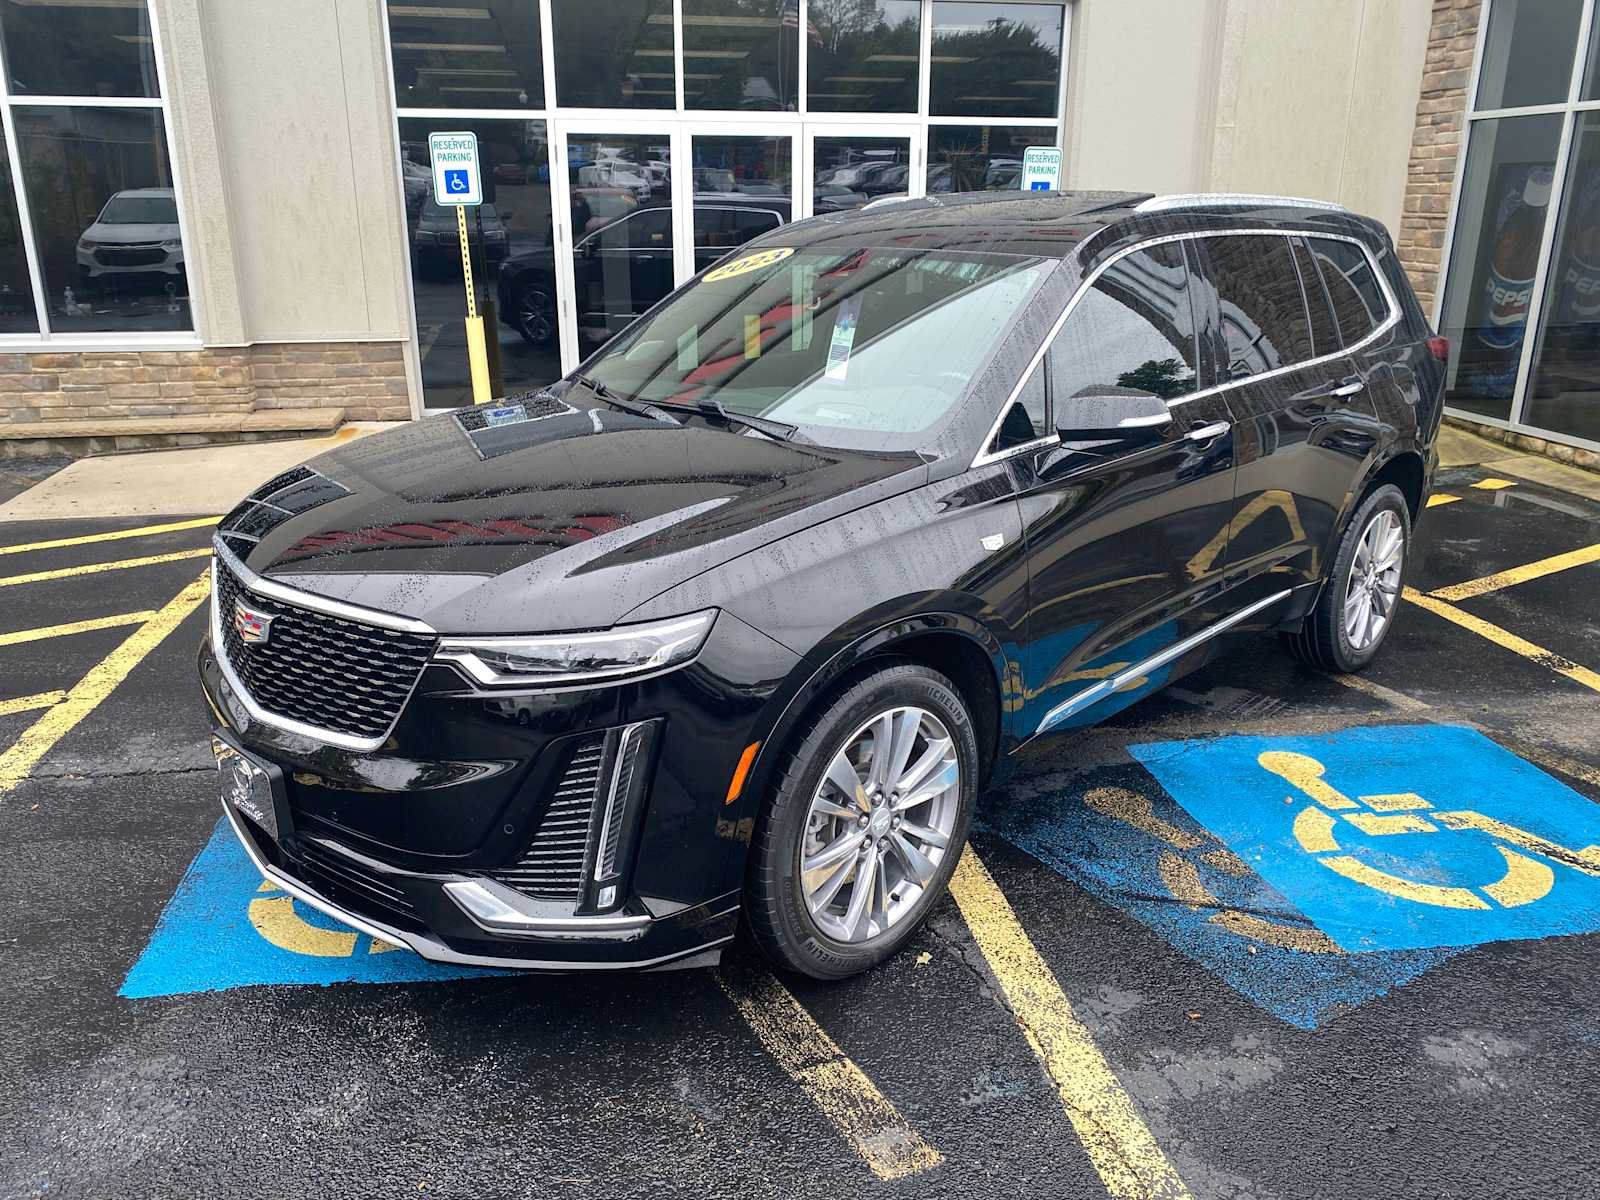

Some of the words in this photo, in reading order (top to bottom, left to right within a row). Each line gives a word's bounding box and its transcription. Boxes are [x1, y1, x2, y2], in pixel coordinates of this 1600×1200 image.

[433, 140, 473, 150] RESERVED
[437, 153, 472, 162] PARKING
[1027, 154, 1059, 163] RESERVED
[1028, 166, 1056, 175] PARKING
[711, 249, 787, 280] 2023
